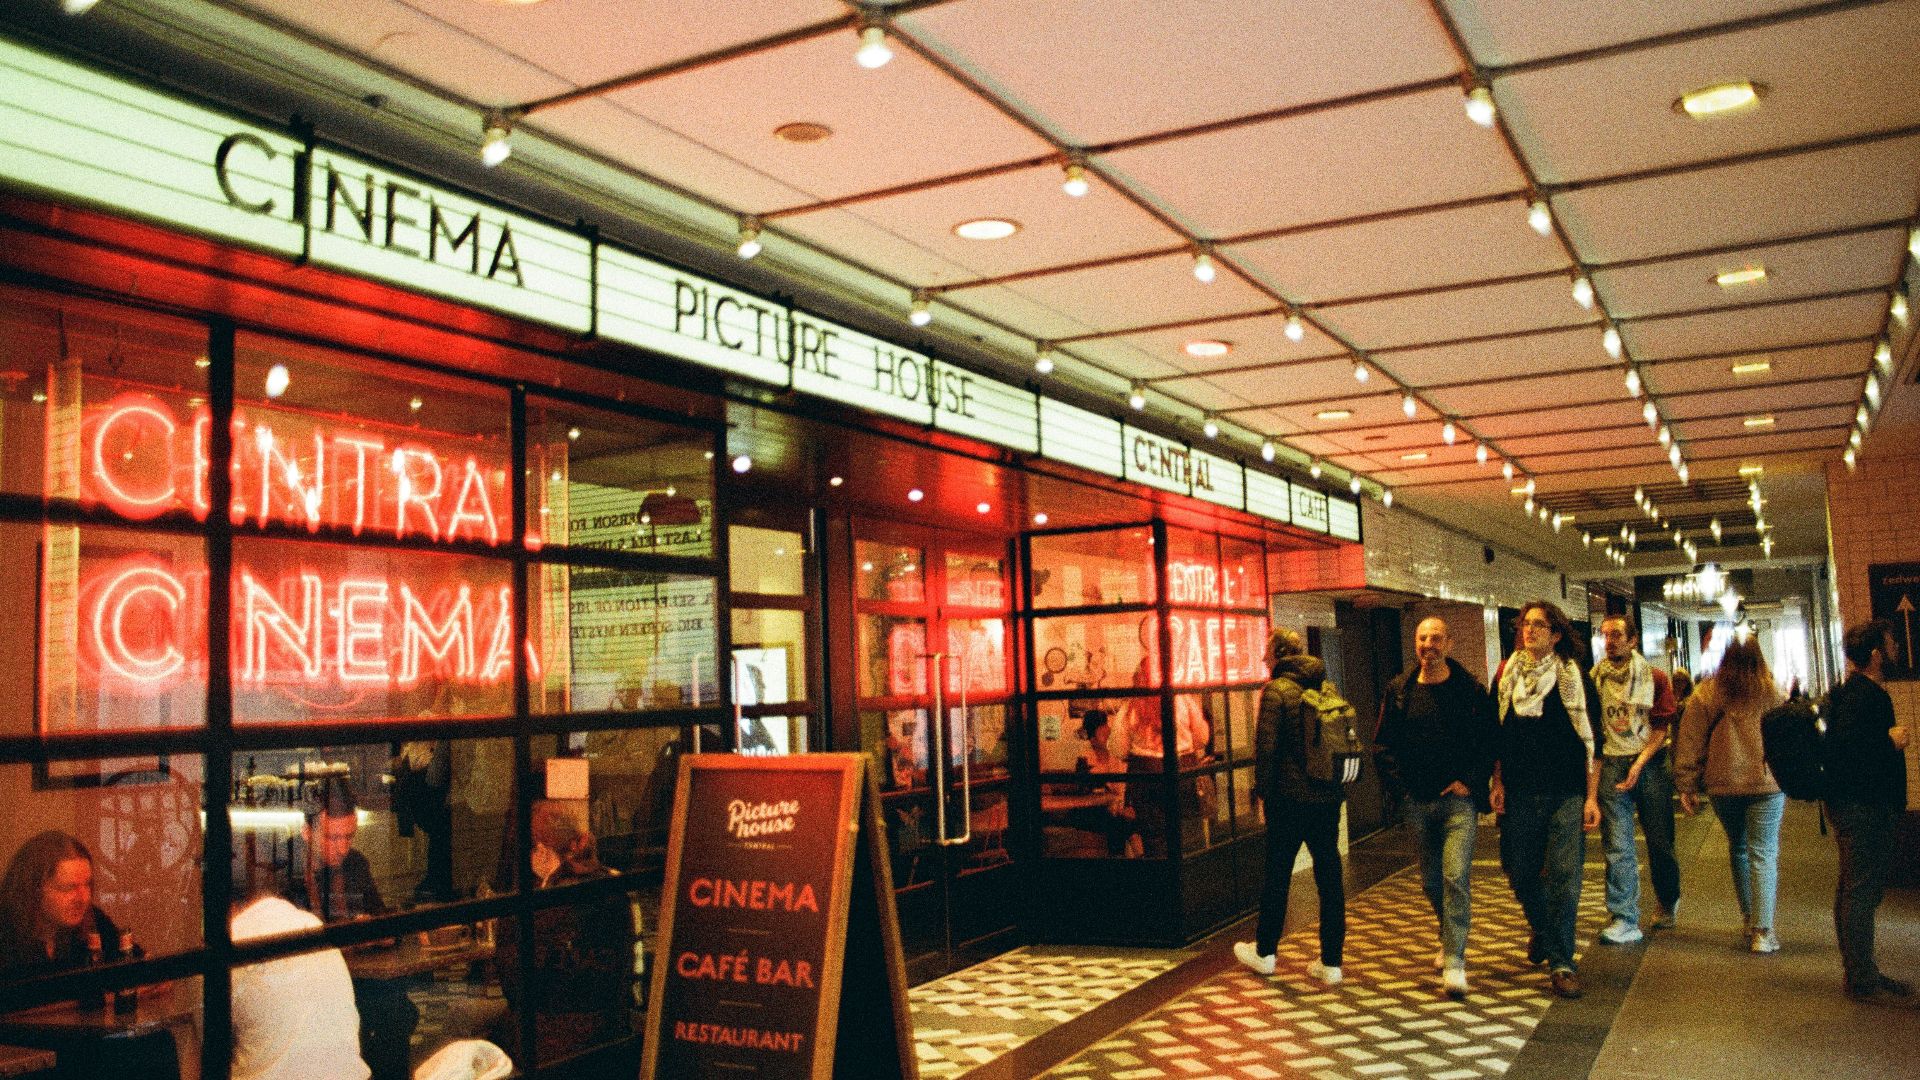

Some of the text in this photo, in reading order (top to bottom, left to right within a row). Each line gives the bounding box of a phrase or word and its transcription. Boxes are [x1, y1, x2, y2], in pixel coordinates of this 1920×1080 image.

[215, 132, 525, 288] CINEMA
[674, 279, 976, 420] PICTURE HOUSE
[92, 404, 543, 543] CENTRA
[1134, 434, 1215, 492] CENTRAL
[93, 566, 541, 682] CNEMA
[727, 798, 800, 833] Picture
[736, 815, 796, 839] house
[688, 877, 820, 913] CINEMA
[676, 950, 814, 988] CAFÉ BAR
[674, 1020, 804, 1051] RESTAURANT
